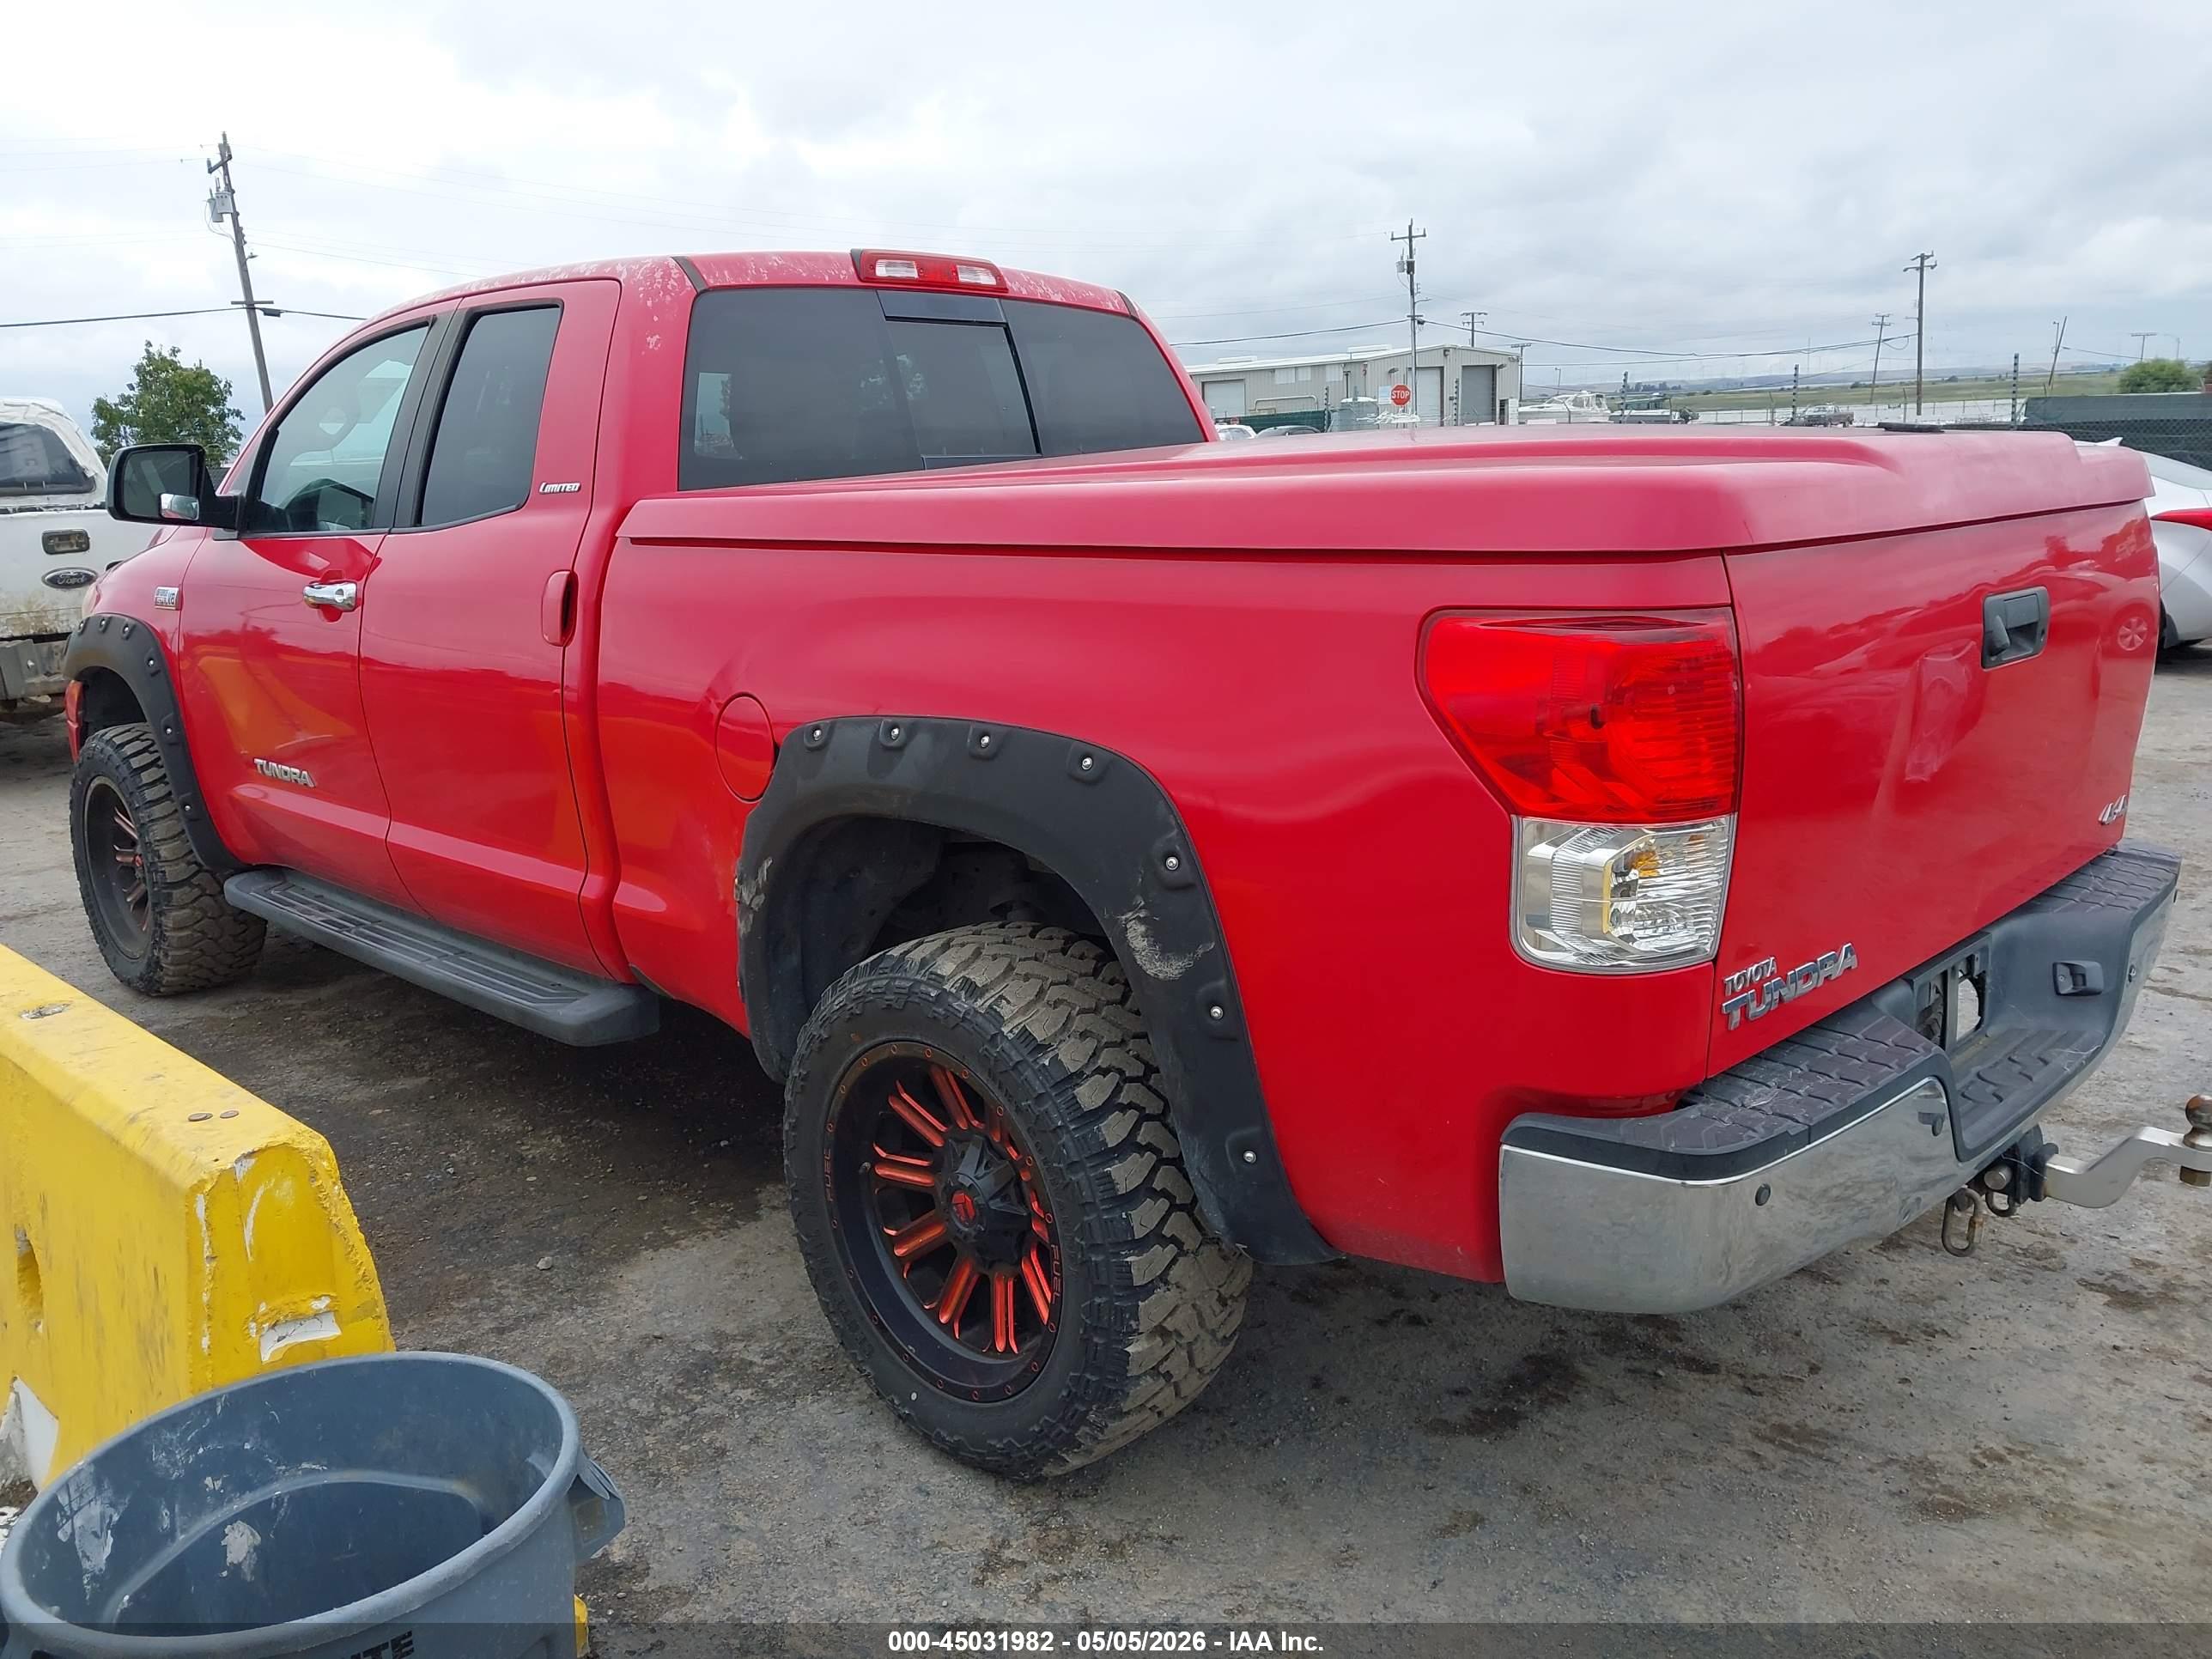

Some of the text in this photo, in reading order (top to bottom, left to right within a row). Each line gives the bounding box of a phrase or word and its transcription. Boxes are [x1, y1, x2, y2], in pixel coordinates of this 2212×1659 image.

[1391, 390, 1410, 399] STOP
[253, 757, 316, 788] TUNDRA
[1722, 942, 1858, 1031] TUNDRA
[1724, 957, 1778, 996] TOYOTA
[1050, 1244, 1061, 1305] FUEL
